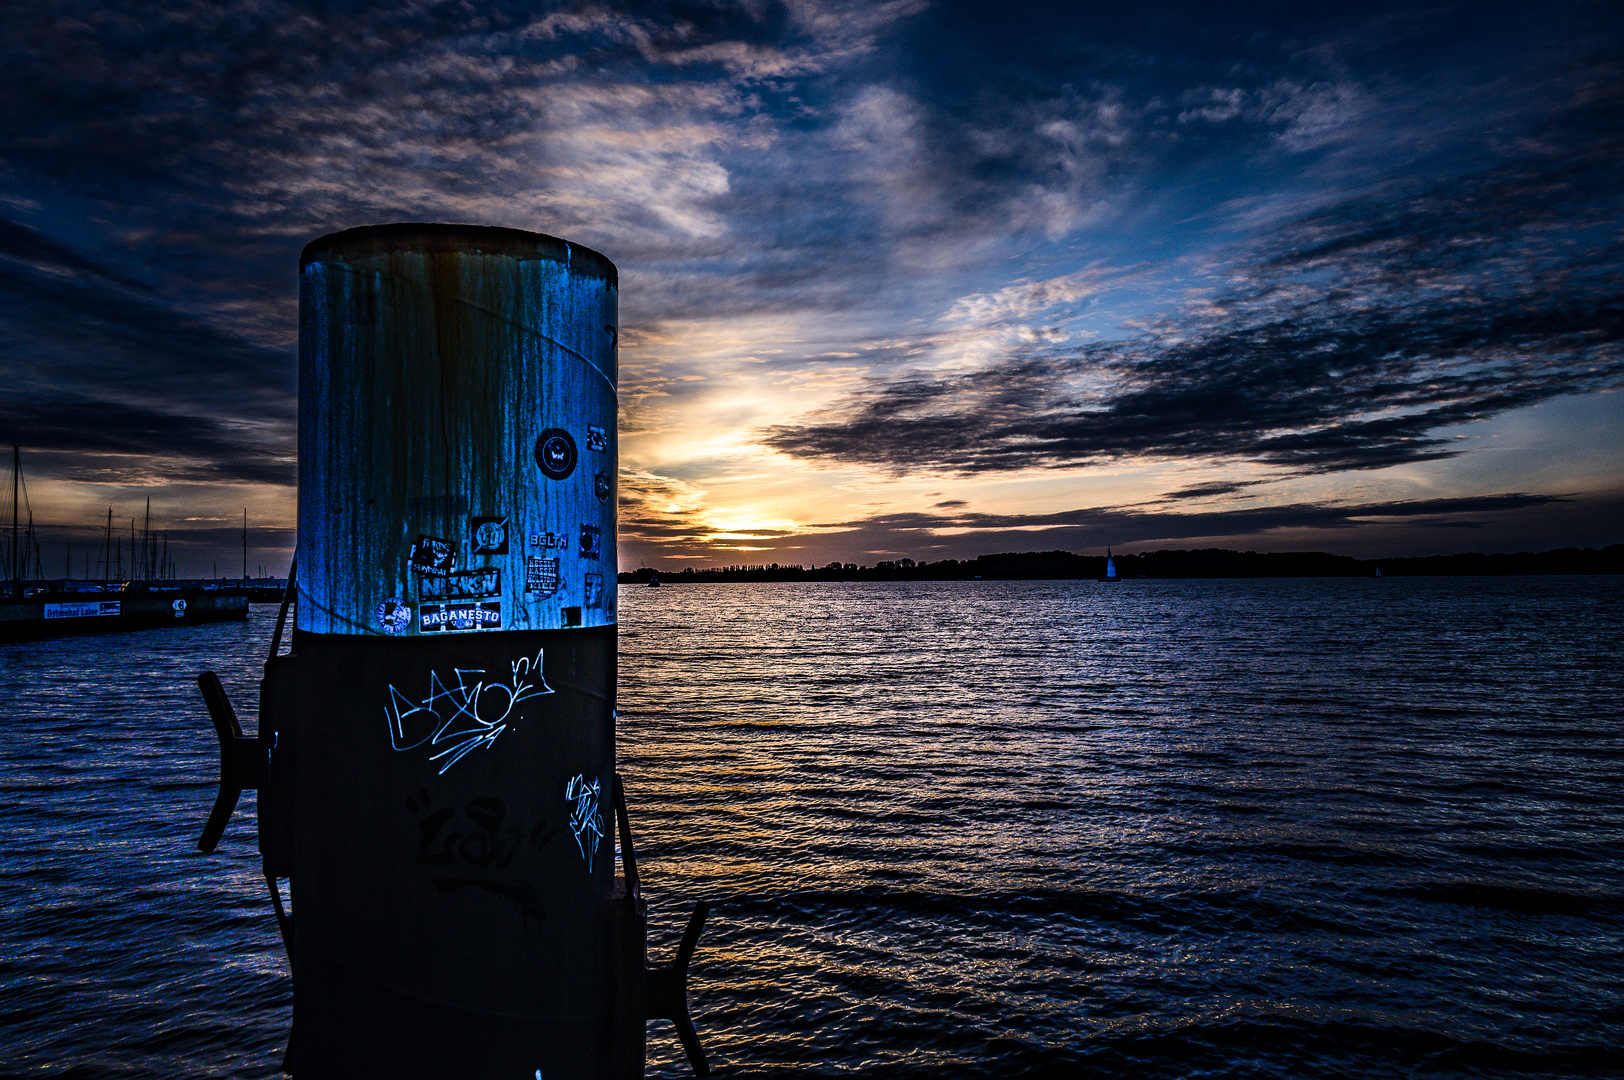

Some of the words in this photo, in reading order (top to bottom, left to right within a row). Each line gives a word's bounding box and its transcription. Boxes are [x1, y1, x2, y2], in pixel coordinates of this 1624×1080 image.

[528, 567, 557, 577] KASSEL
[81, 607, 99, 616] Laboe
[421, 609, 500, 625] BAGANESTO
